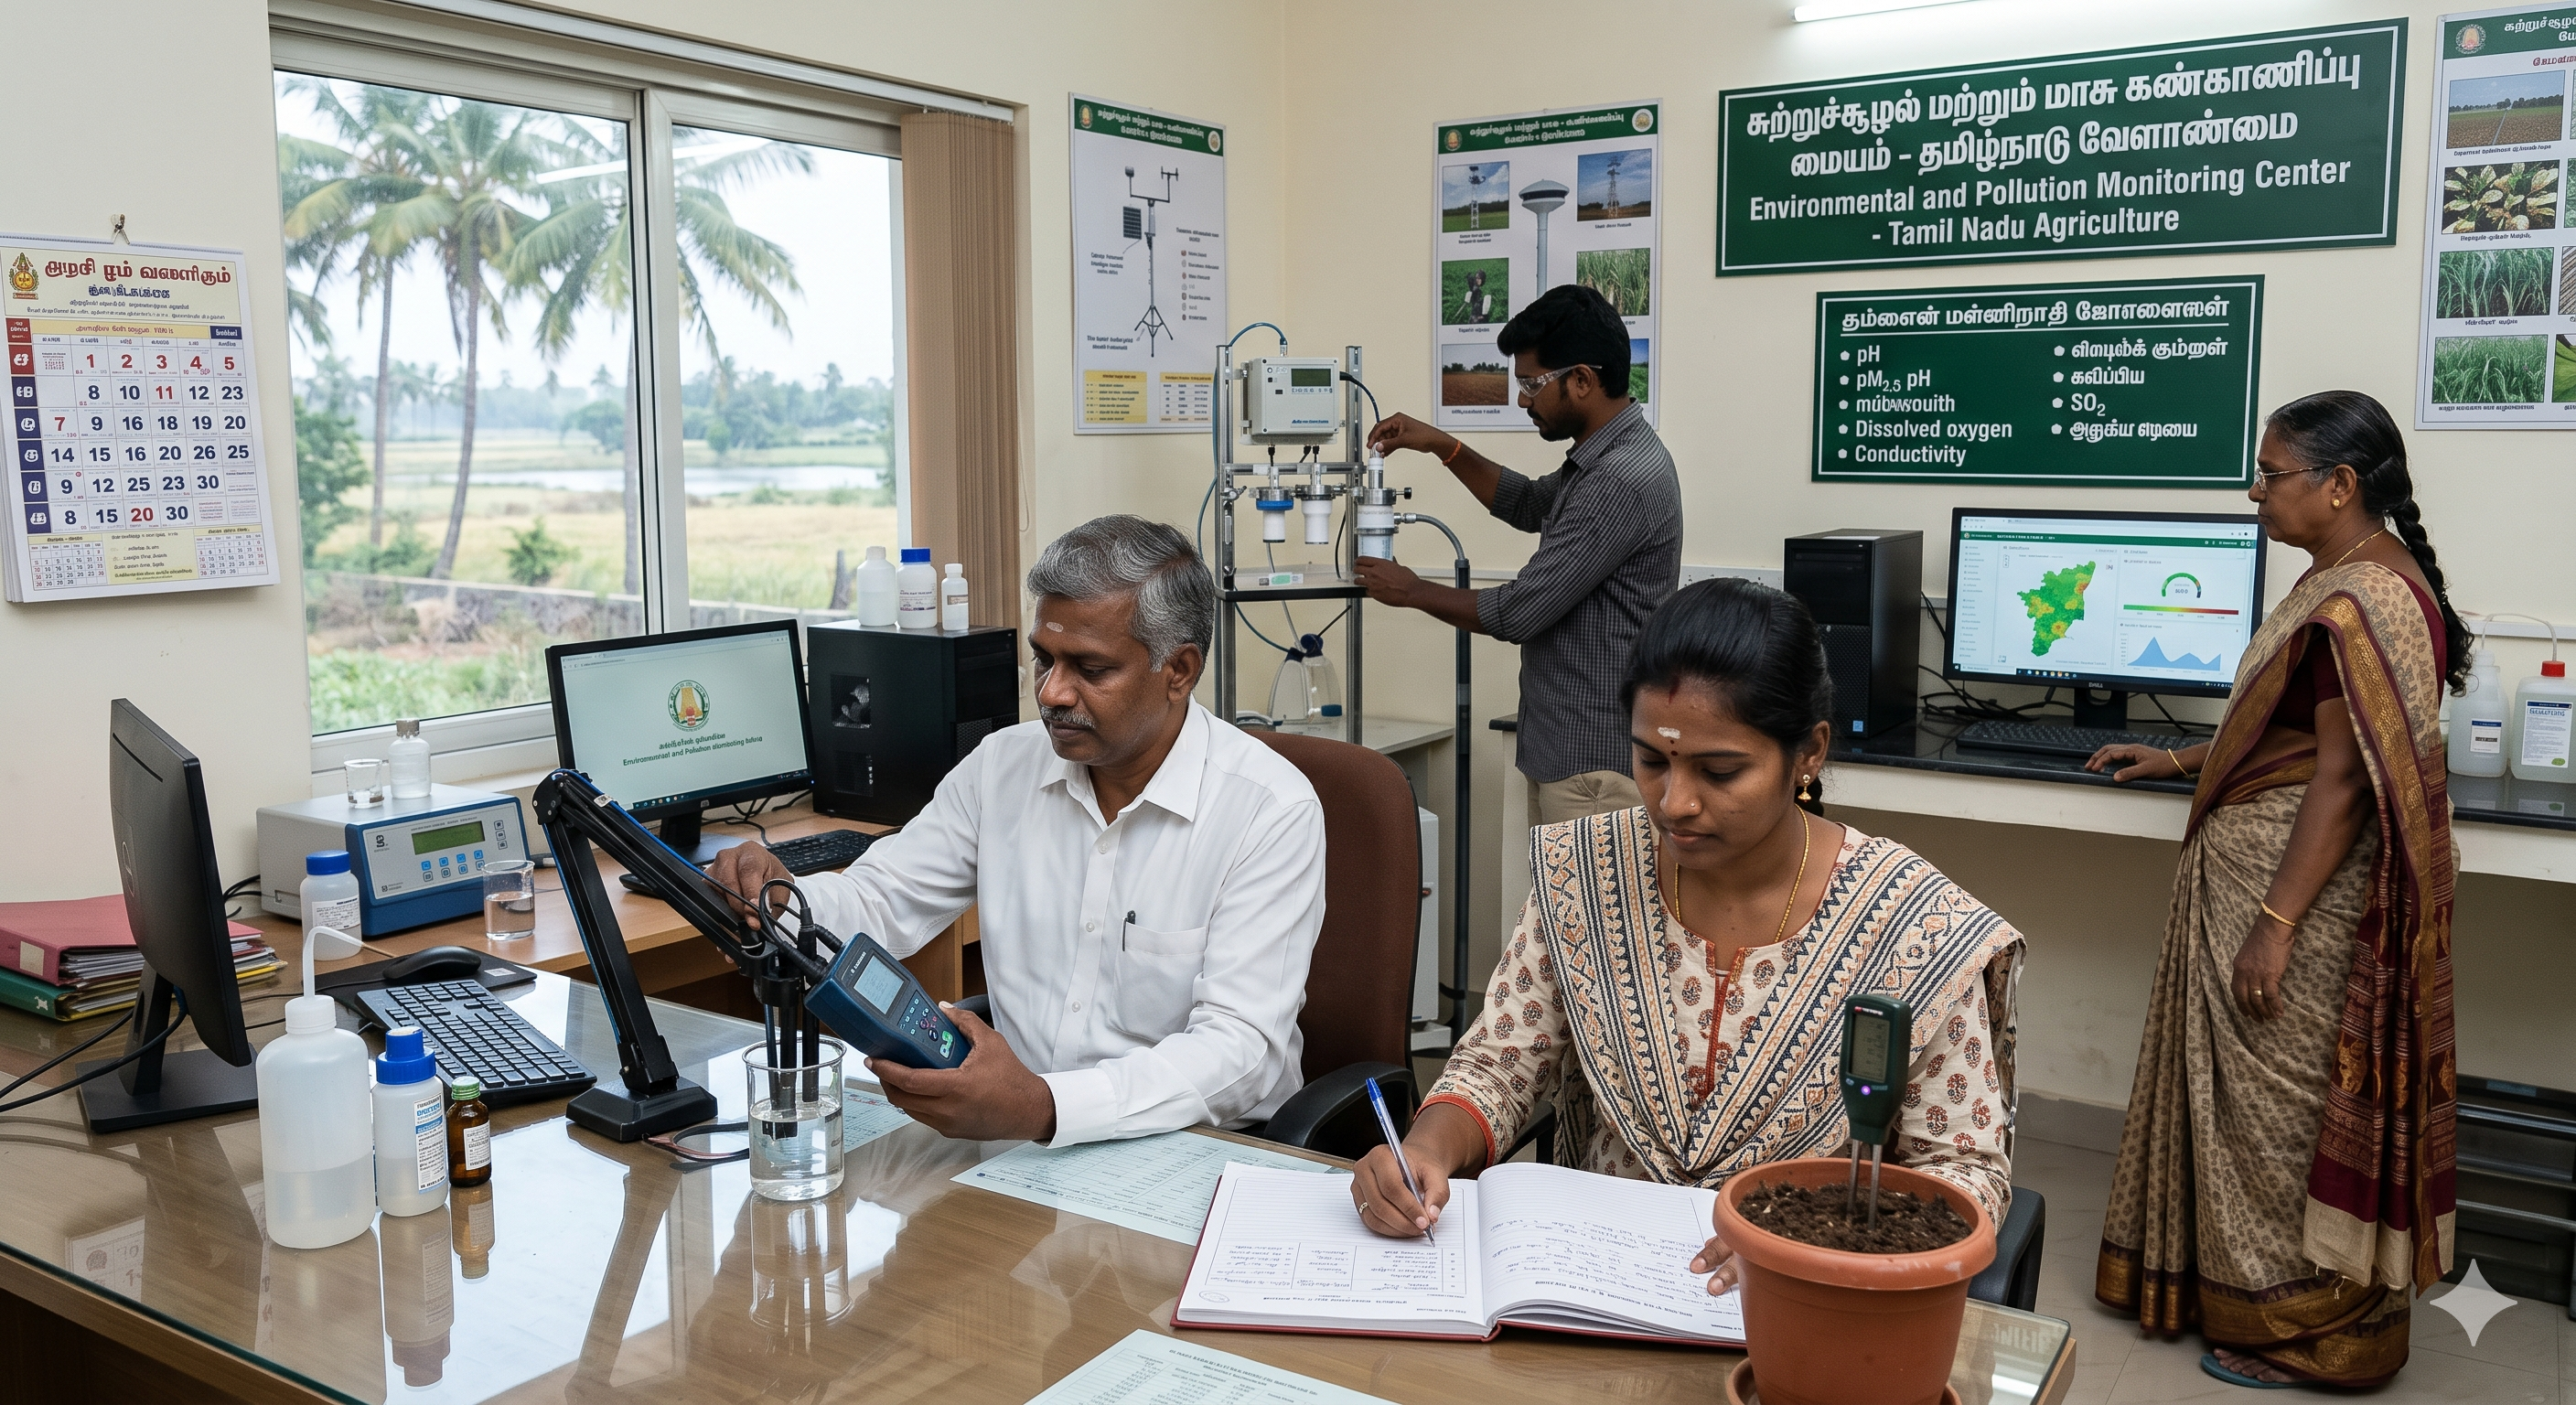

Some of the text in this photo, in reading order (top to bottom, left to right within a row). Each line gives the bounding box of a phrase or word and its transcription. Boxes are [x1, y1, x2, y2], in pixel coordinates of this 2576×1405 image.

[1747, 47, 2360, 143] சுற்றுச்சூழல் மற்றும் மாசு கண்காணிப்பு
[1790, 137, 1891, 177] மையம்
[1918, 126, 2070, 176] தமிழ்நாடு
[2078, 109, 2298, 155] வேளாண்மை
[1750, 158, 2351, 220] Environmental and Pollution Monitoring Center
[1888, 218, 1953, 245] Tamil
[1962, 214, 2025, 242] Nadu
[2034, 208, 2180, 242] Agriculture
[86, 354, 236, 370] 1 2 3 4 5
[1857, 345, 1881, 367] pH
[1906, 370, 1931, 391] pH
[88, 384, 244, 401] 8 10 11 12 23
[54, 414, 247, 432] 7 9 16 18 19 20
[1856, 420, 2012, 442] Dissolved oxygen
[50, 444, 251, 463] 14 15 16 20 26 25
[1855, 445, 1967, 467] Conductivity
[60, 478, 73, 495] 9
[92, 477, 115, 493] 12
[126, 476, 151, 492] 25
[162, 476, 186, 491] 23
[196, 474, 220, 490] 30
[64, 505, 189, 525] 8 15 20 30
[671, 749, 684, 757] and
